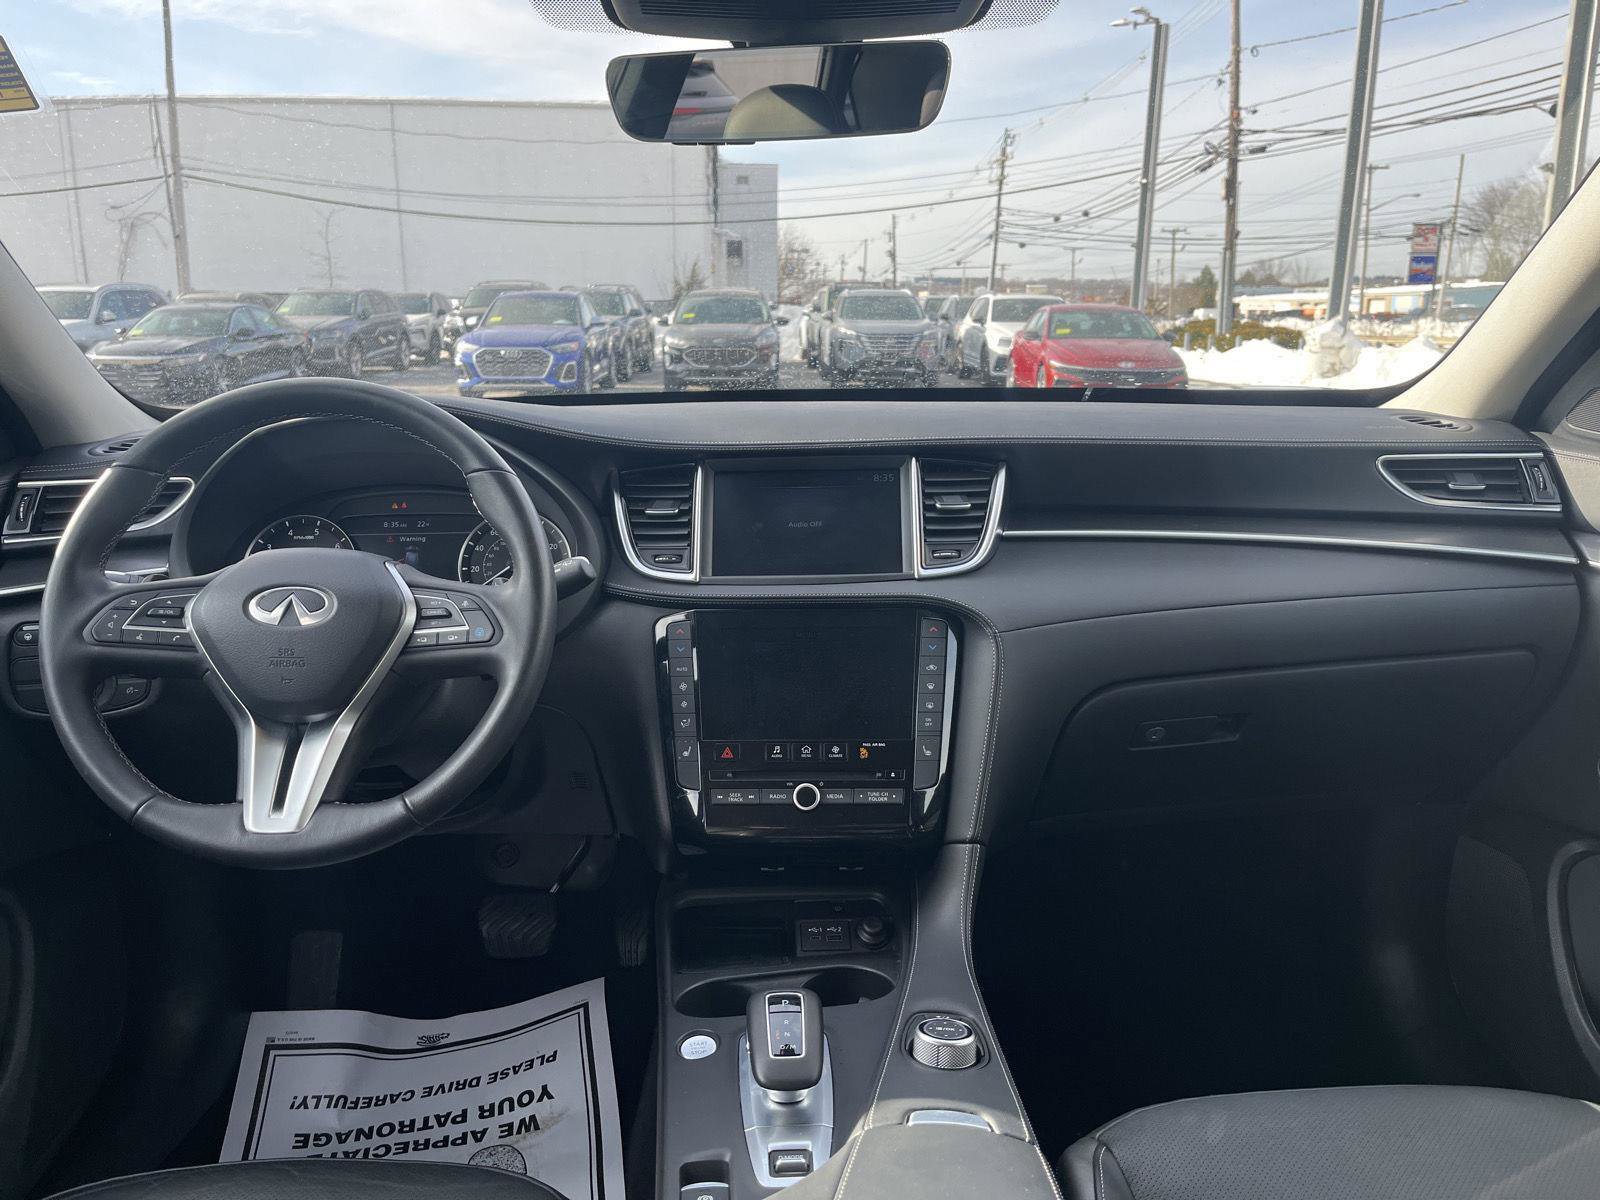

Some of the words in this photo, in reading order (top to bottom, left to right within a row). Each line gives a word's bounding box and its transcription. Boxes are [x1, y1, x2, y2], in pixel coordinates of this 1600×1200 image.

[873, 473, 895, 482] 8:35
[788, 520, 808, 528] Audio
[314, 528, 320, 536] 5
[470, 565, 480, 573] 20
[278, 647, 296, 657] SRS
[268, 659, 306, 668] AIRBAG
[781, 999, 790, 1007] P
[486, 1049, 558, 1085] PLEASE
[420, 1075, 482, 1098] DRIVE
[288, 1089, 416, 1110] CAREFULLY!
[477, 1084, 555, 1120] YOUR
[291, 1108, 468, 1150] PATRONAGE
[498, 1113, 541, 1139] WE
[306, 1127, 489, 1159] APPRECIA
